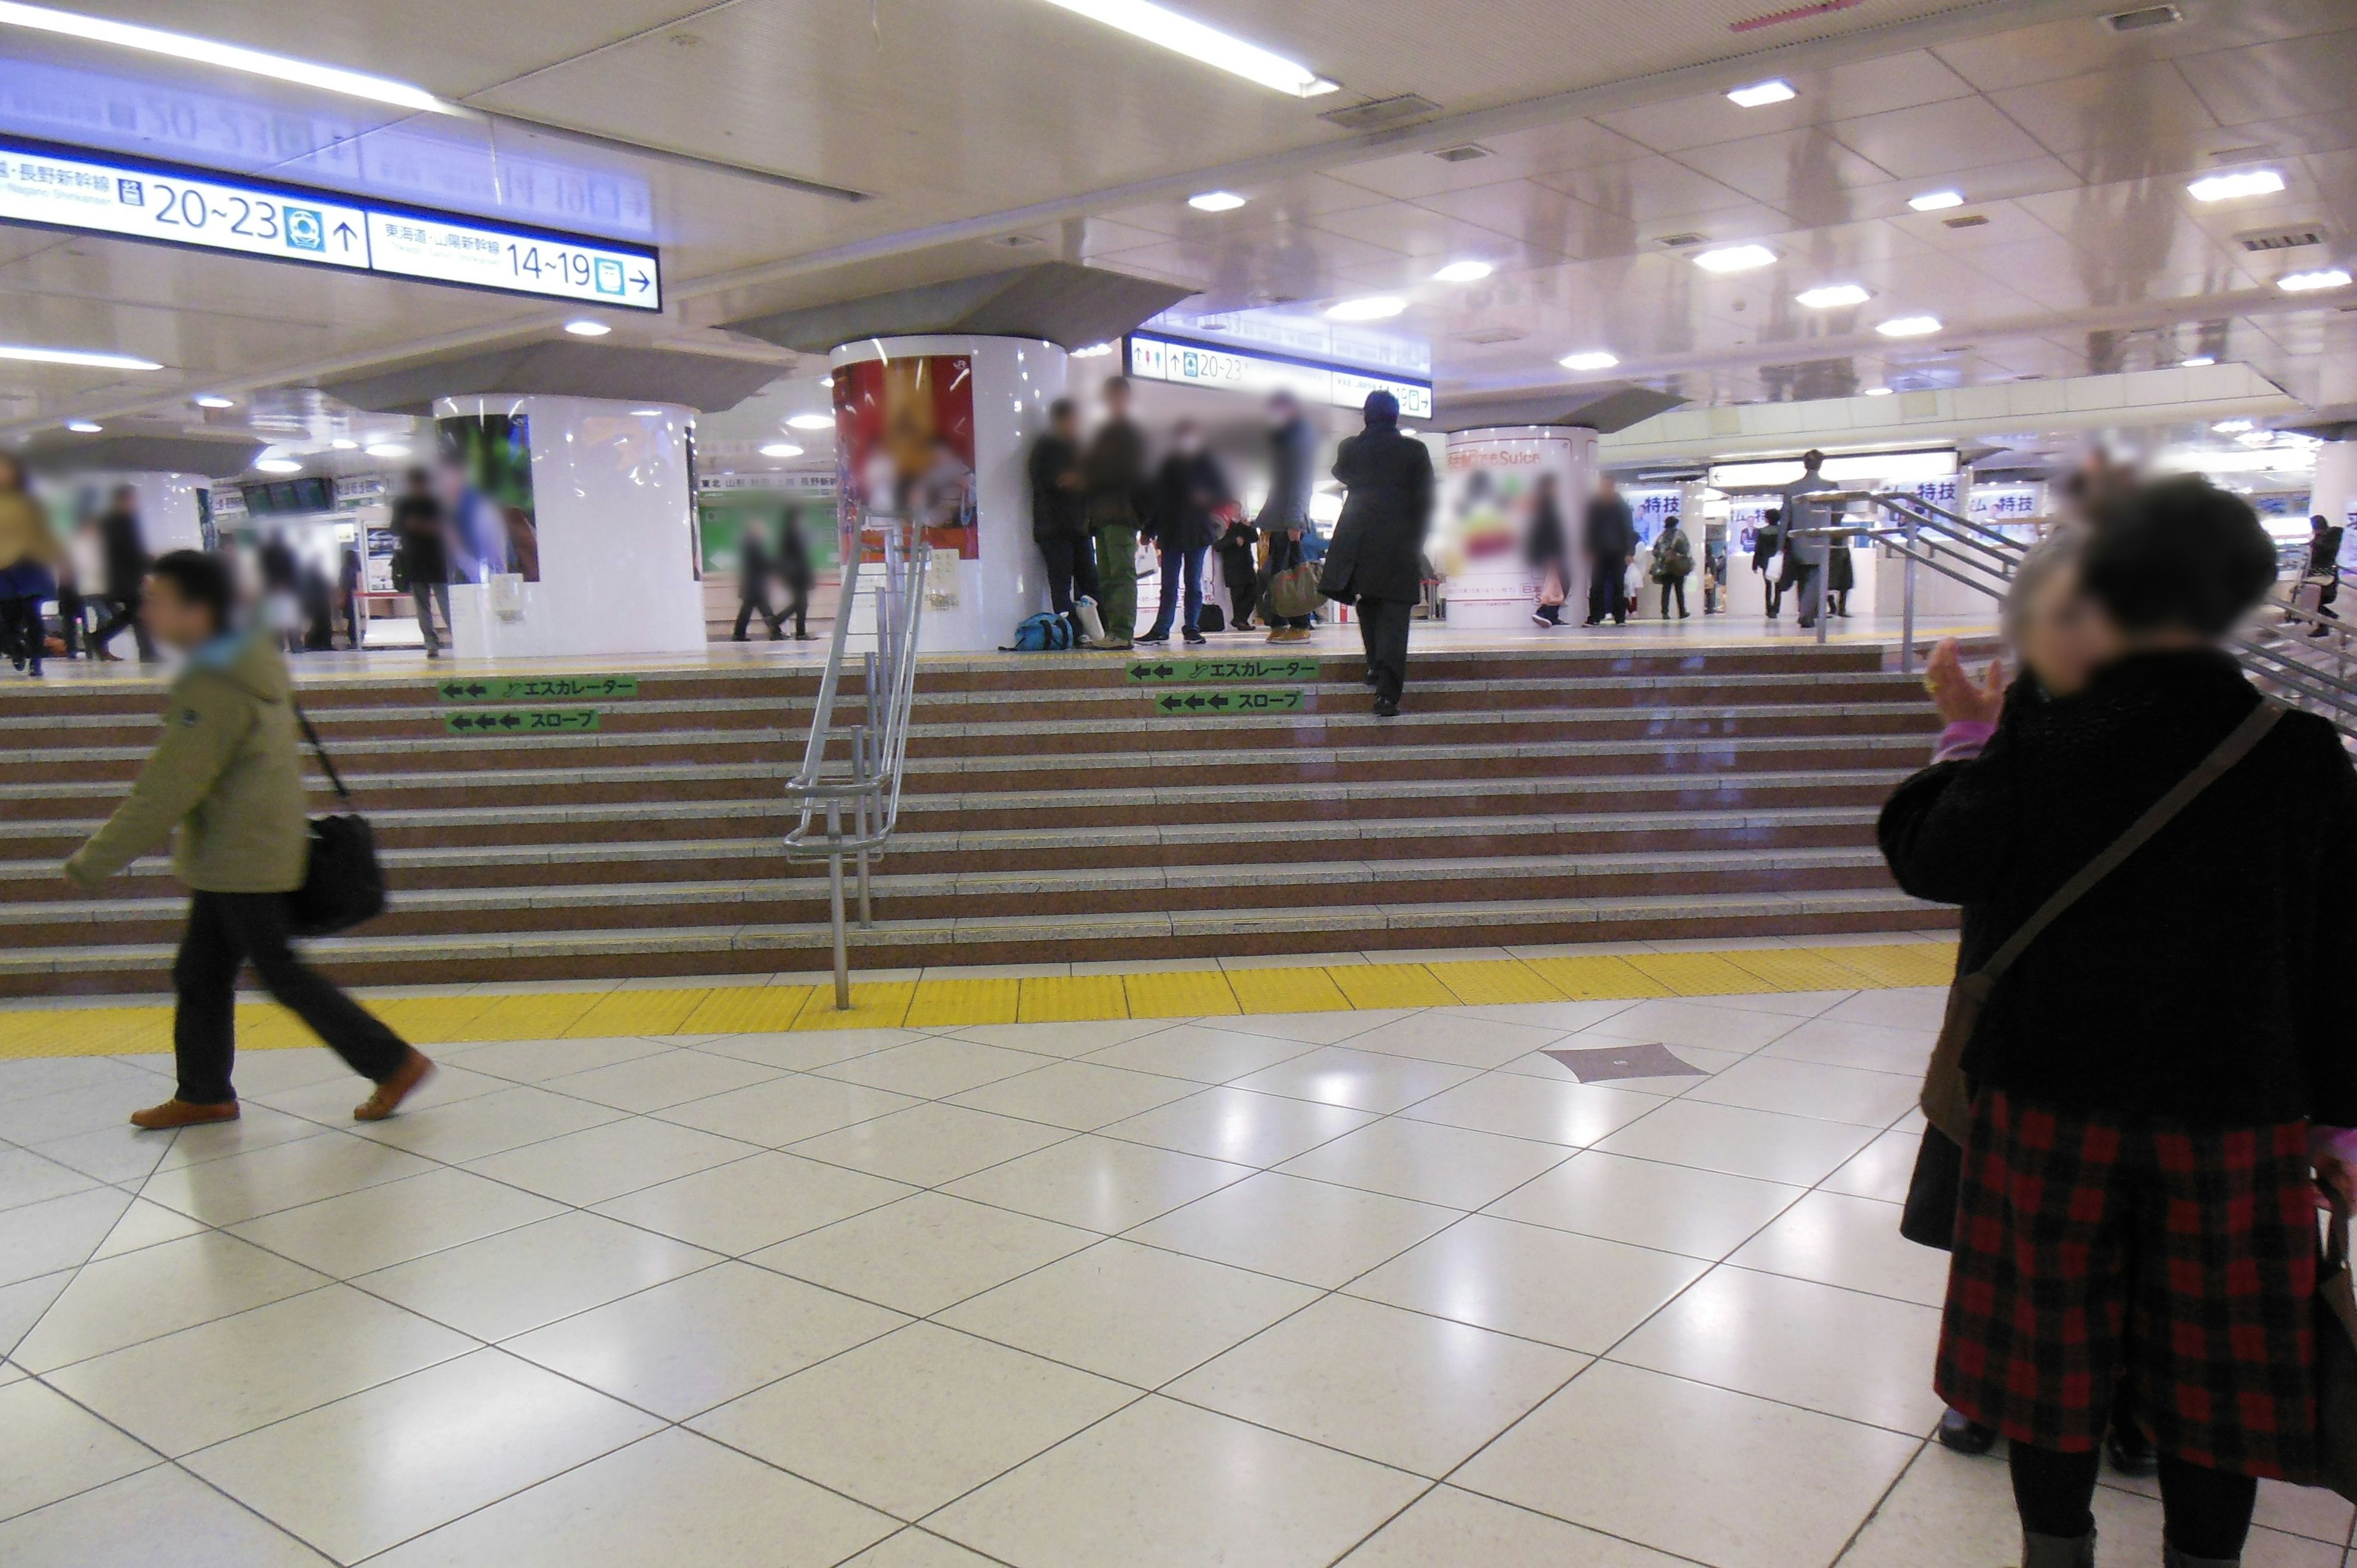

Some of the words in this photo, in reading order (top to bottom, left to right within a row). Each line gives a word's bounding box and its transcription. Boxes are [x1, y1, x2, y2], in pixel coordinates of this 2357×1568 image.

[1917, 482, 1956, 500] 特技
[1645, 495, 1680, 514] 特技
[1999, 496, 2034, 512] 特技
[1210, 662, 1315, 678] エスカレーター
[525, 679, 633, 695] エスカレーター
[1238, 691, 1302, 708] スロープ
[530, 710, 595, 727] スロープ
